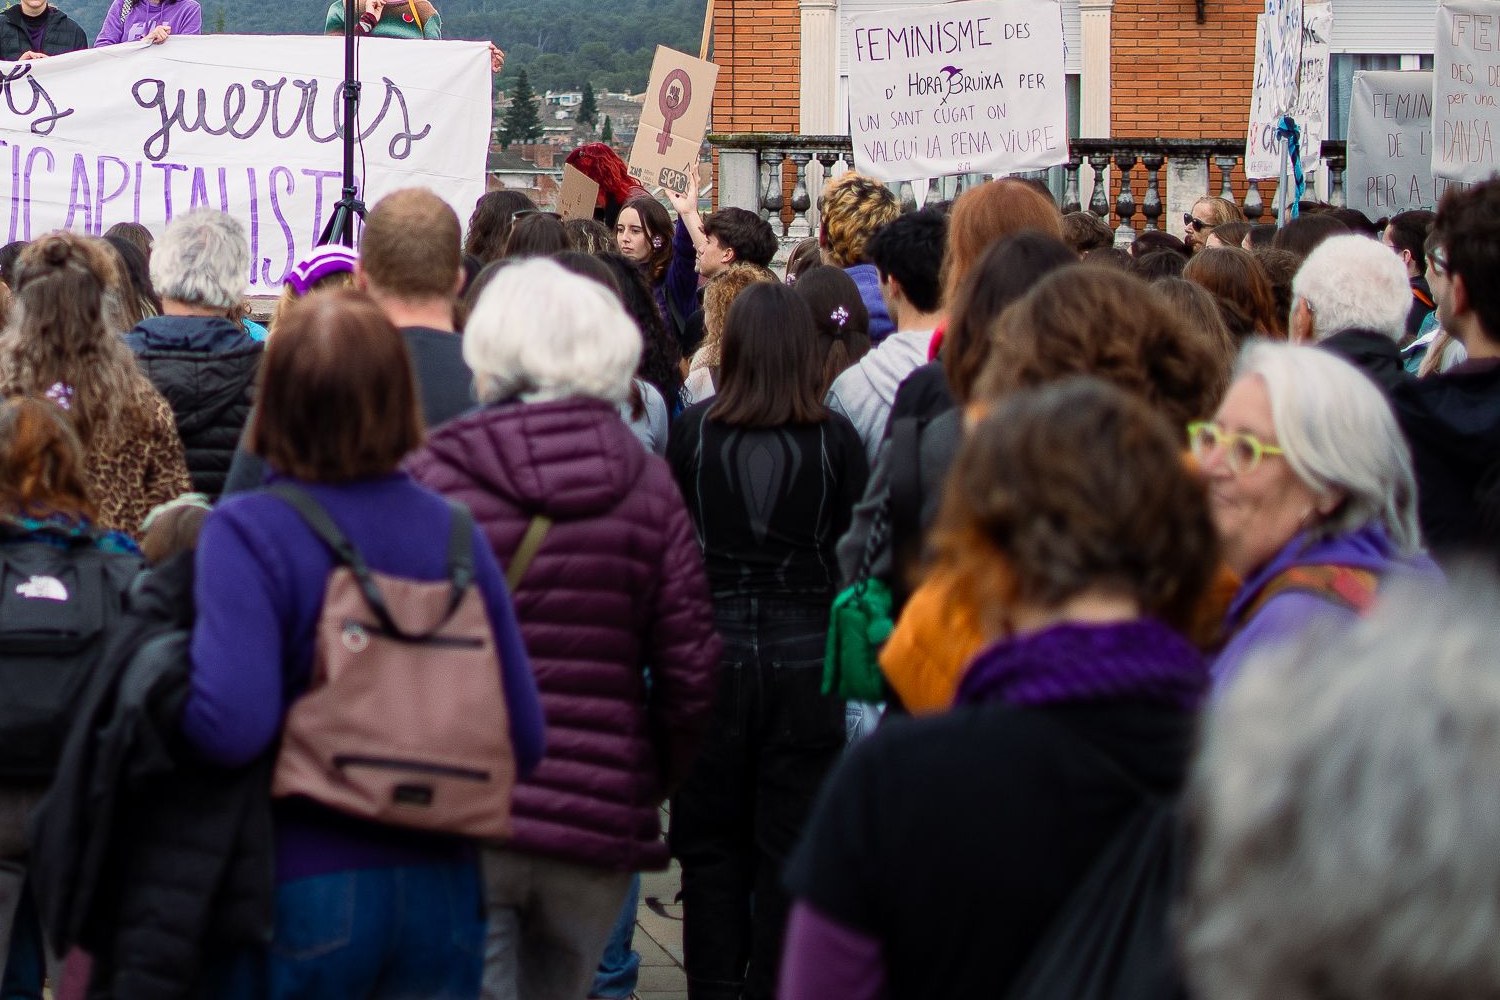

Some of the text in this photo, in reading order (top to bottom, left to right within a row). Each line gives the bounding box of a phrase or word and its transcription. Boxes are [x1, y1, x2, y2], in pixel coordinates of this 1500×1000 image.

[855, 17, 1030, 62] FEMINISME DES
[908, 72, 943, 97] HORA
[948, 70, 1004, 95] BRUIXA
[1019, 73, 1046, 90] PER
[1451, 63, 1474, 85] DES
[858, 102, 1007, 132] UN SANT CUGAT ON
[1372, 92, 1432, 119] FEMIN
[1446, 92, 1499, 114] per una
[131, 76, 432, 161] guerres
[864, 125, 1057, 163] VALGUI LA PENA VIURE
[1387, 132, 1404, 158] DE
[1442, 118, 1494, 164] DANSA
[1366, 173, 1397, 207] PER
[1409, 174, 1422, 205] A
